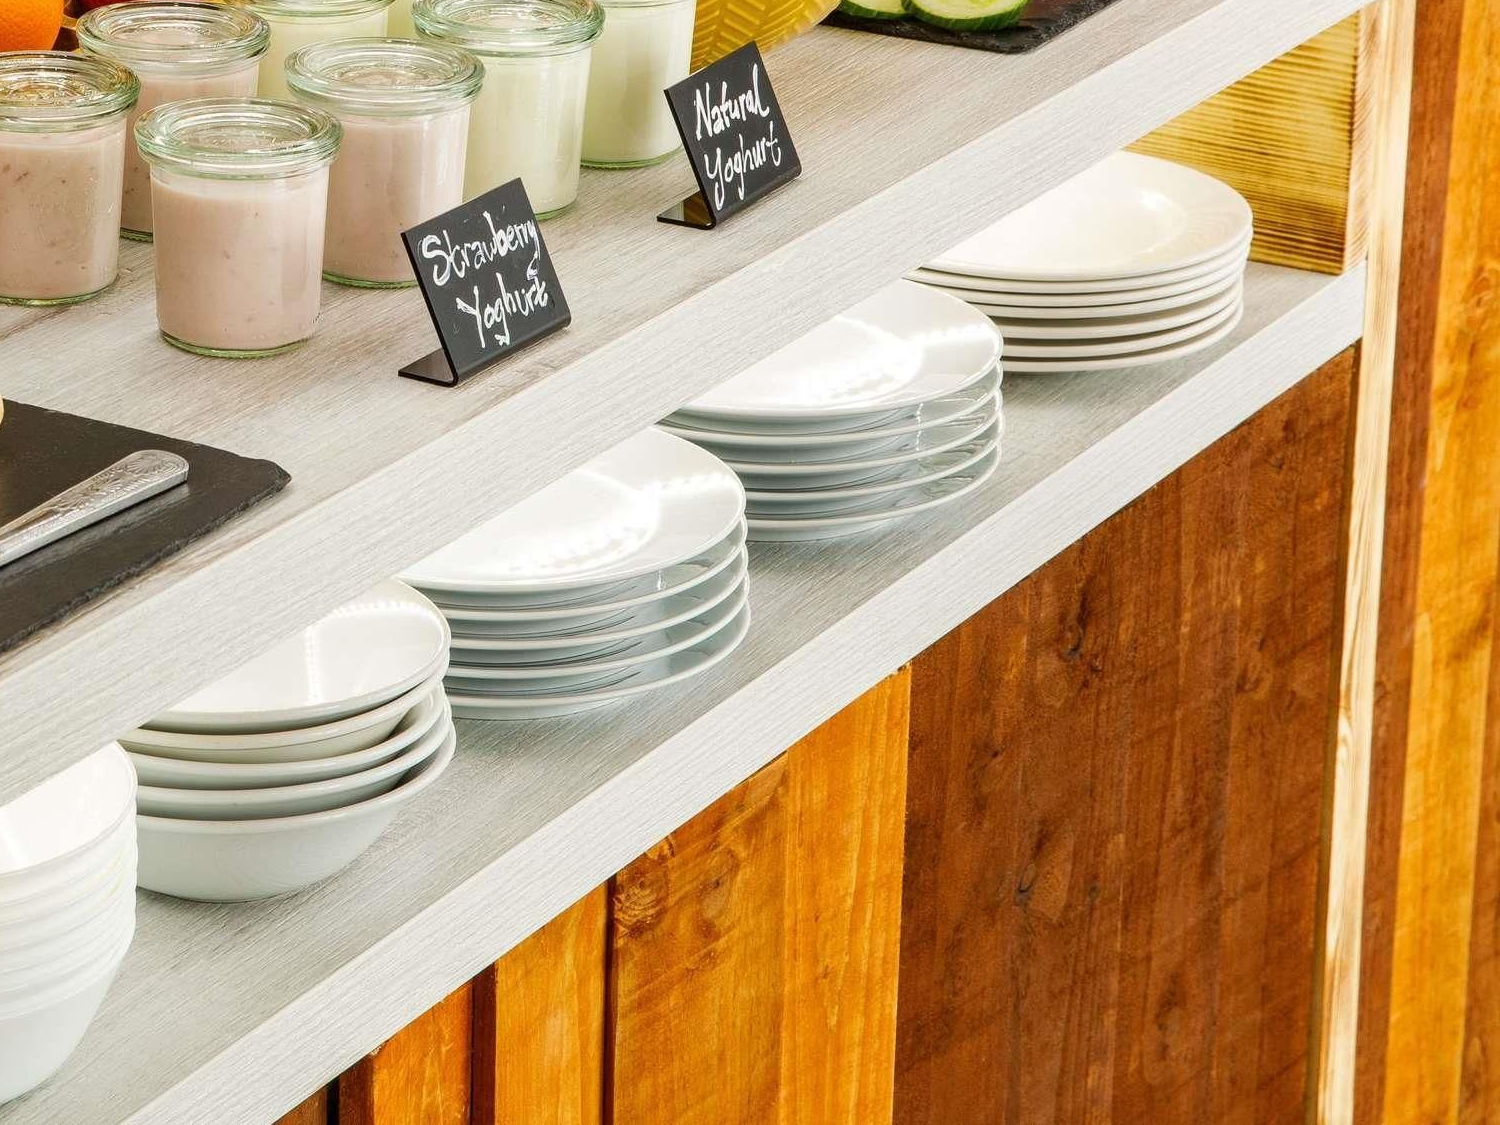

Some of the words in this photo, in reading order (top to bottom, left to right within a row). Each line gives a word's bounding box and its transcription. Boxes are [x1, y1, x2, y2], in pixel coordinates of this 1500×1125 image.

[693, 62, 770, 141] Natural
[703, 120, 781, 211] Yoghurt
[421, 210, 542, 287] Strawberry
